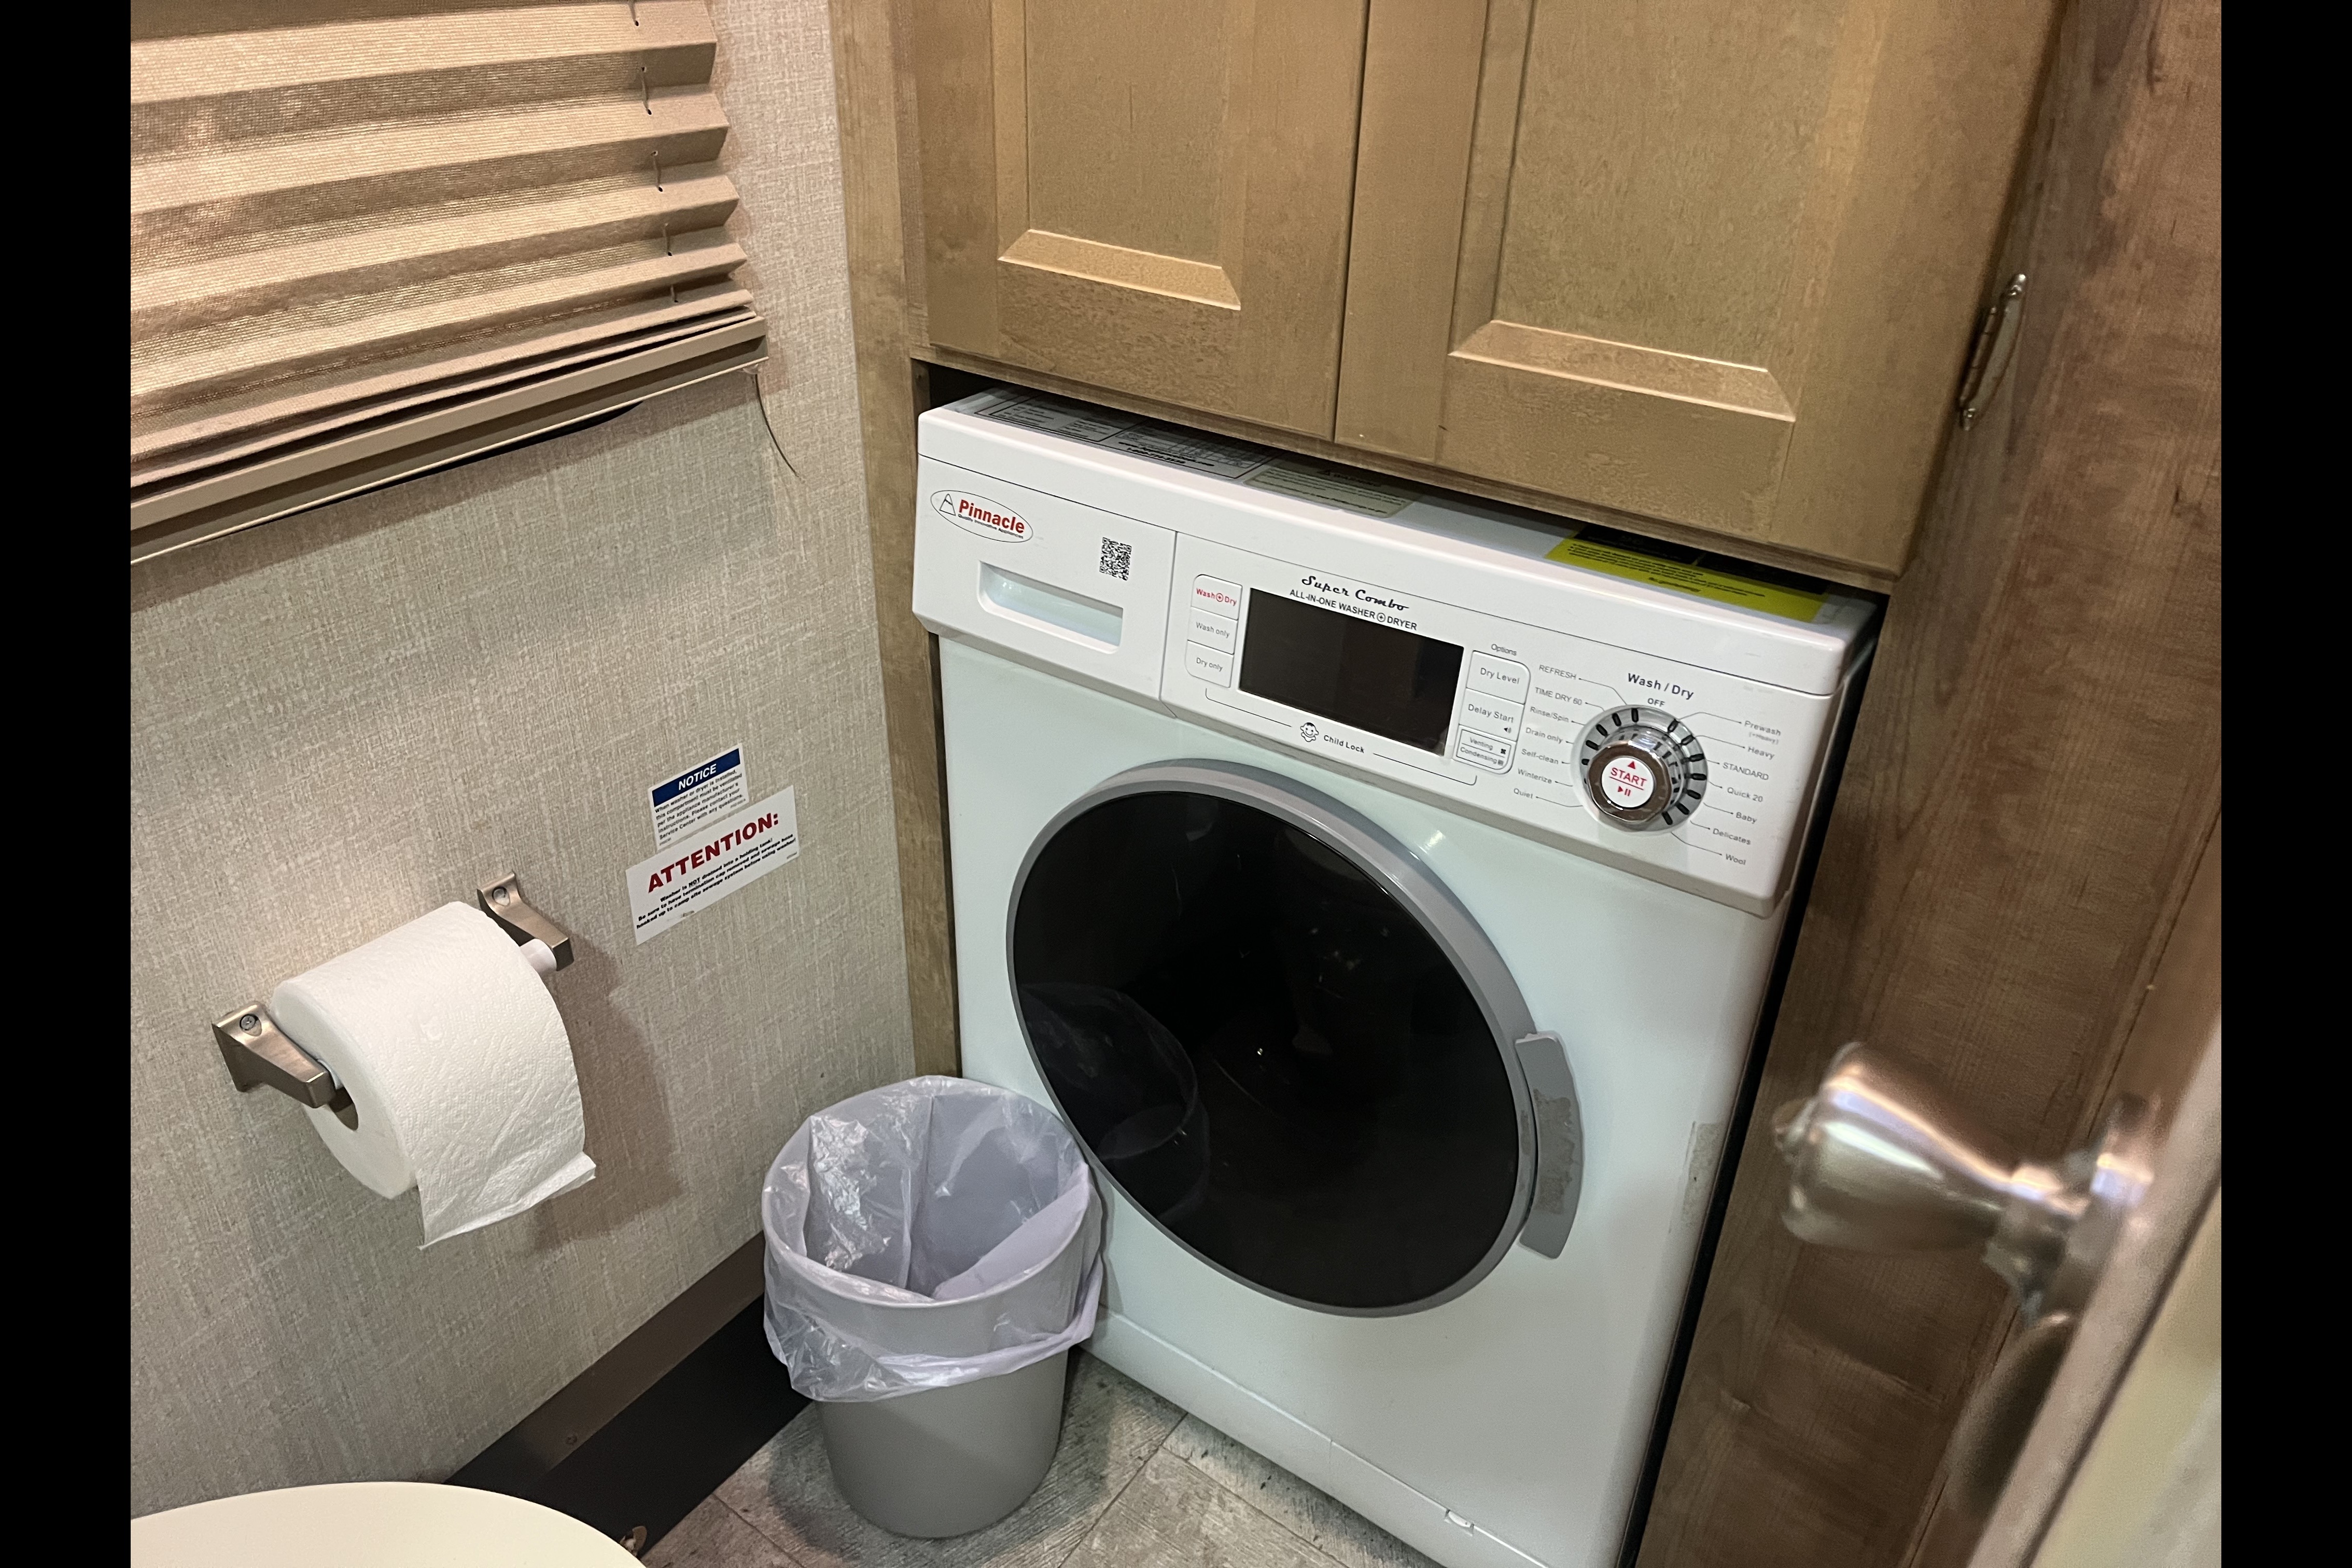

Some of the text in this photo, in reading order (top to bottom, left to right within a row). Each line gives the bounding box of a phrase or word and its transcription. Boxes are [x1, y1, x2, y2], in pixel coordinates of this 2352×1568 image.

[959, 499, 1025, 533] Pinnacle
[1301, 576, 1409, 611] Super Combo
[1290, 589, 1418, 631] ALL-IN-ONE WASHER DRYER
[1196, 621, 1230, 639] Wash only
[1491, 643, 1517, 656] Options
[1196, 657, 1223, 672] Dry only
[1539, 665, 1577, 680] REFRESH
[1480, 667, 1520, 685] Dry Level
[1535, 687, 1553, 697] TIME
[1555, 693, 1572, 703] DRY
[1628, 673, 1661, 691] Wash
[1671, 685, 1694, 700] Dry
[1647, 697, 1665, 708] OFF
[1468, 704, 1514, 723] Delay Start
[1530, 706, 1569, 723] Rinse/Spin
[1525, 727, 1563, 744] Drain only
[1744, 721, 1781, 737] Prewash
[1324, 735, 1365, 754] Child Lock
[1469, 737, 1493, 751] Venting
[1460, 746, 1497, 765] Condensing
[1521, 749, 1558, 765] Self-clean
[1747, 746, 1774, 760] Heavy
[679, 764, 716, 790] NOTICE
[1517, 768, 1552, 784] Winterize
[1611, 767, 1647, 788] START
[1723, 762, 1769, 780] STANDARD
[1514, 788, 1533, 799] Quiet
[1727, 787, 1752, 799] Quick
[655, 804, 669, 813] When
[692, 805, 708, 815] Please
[1736, 812, 1757, 824] Baby
[660, 828, 678, 839] Service
[679, 819, 695, 829] Center
[1713, 828, 1752, 846] Delicates
[648, 813, 778, 893] ATTENTION:
[1725, 853, 1746, 866] Wool
[661, 889, 680, 902] Washer
[689, 877, 700, 887] NOT
